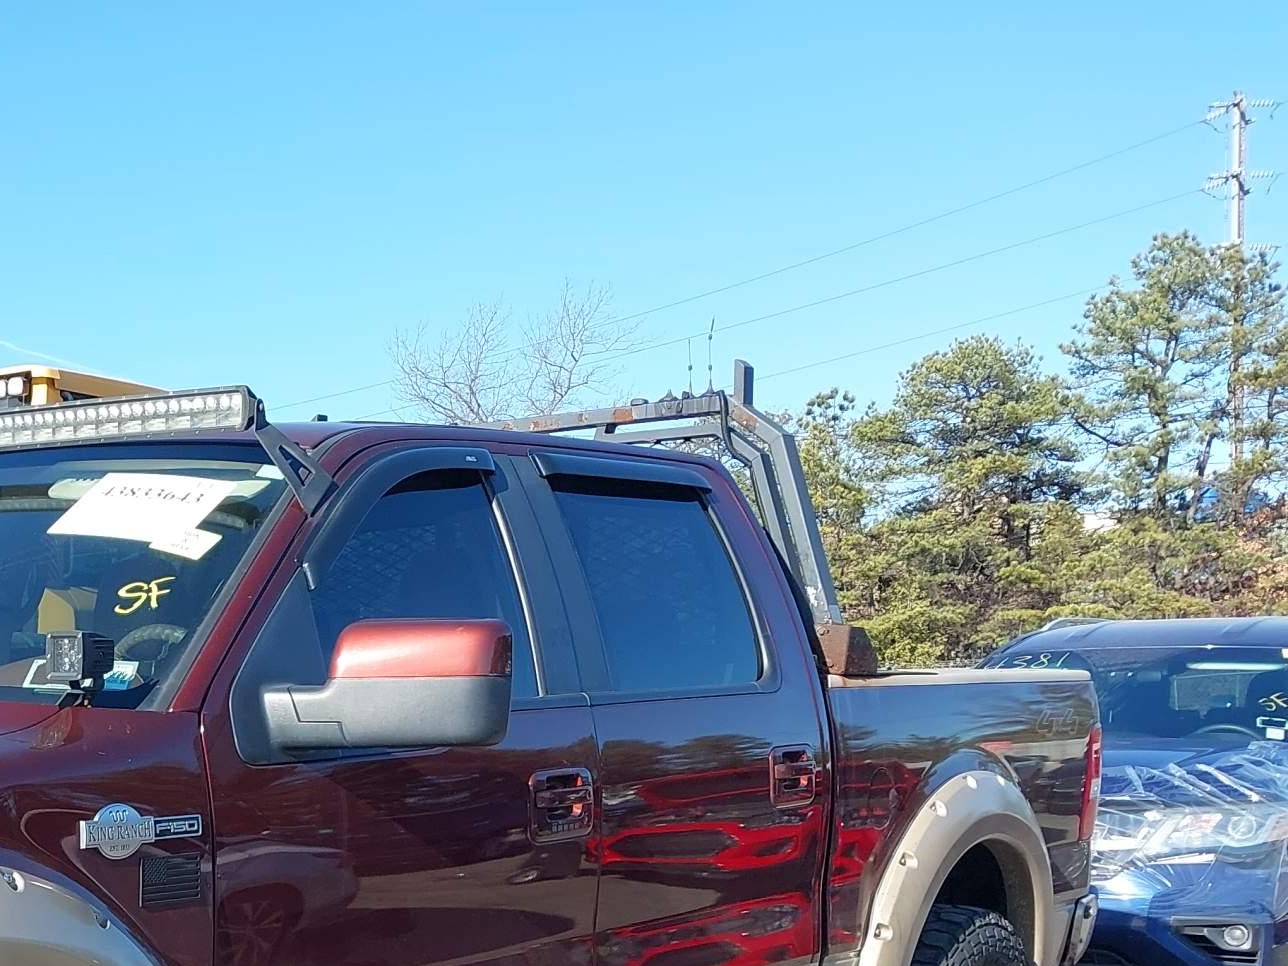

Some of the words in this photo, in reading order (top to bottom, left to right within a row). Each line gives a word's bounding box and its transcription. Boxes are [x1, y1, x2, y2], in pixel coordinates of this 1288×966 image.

[113, 575, 177, 615] SF
[88, 824, 115, 843] KING
[117, 820, 152, 841] RANCH
